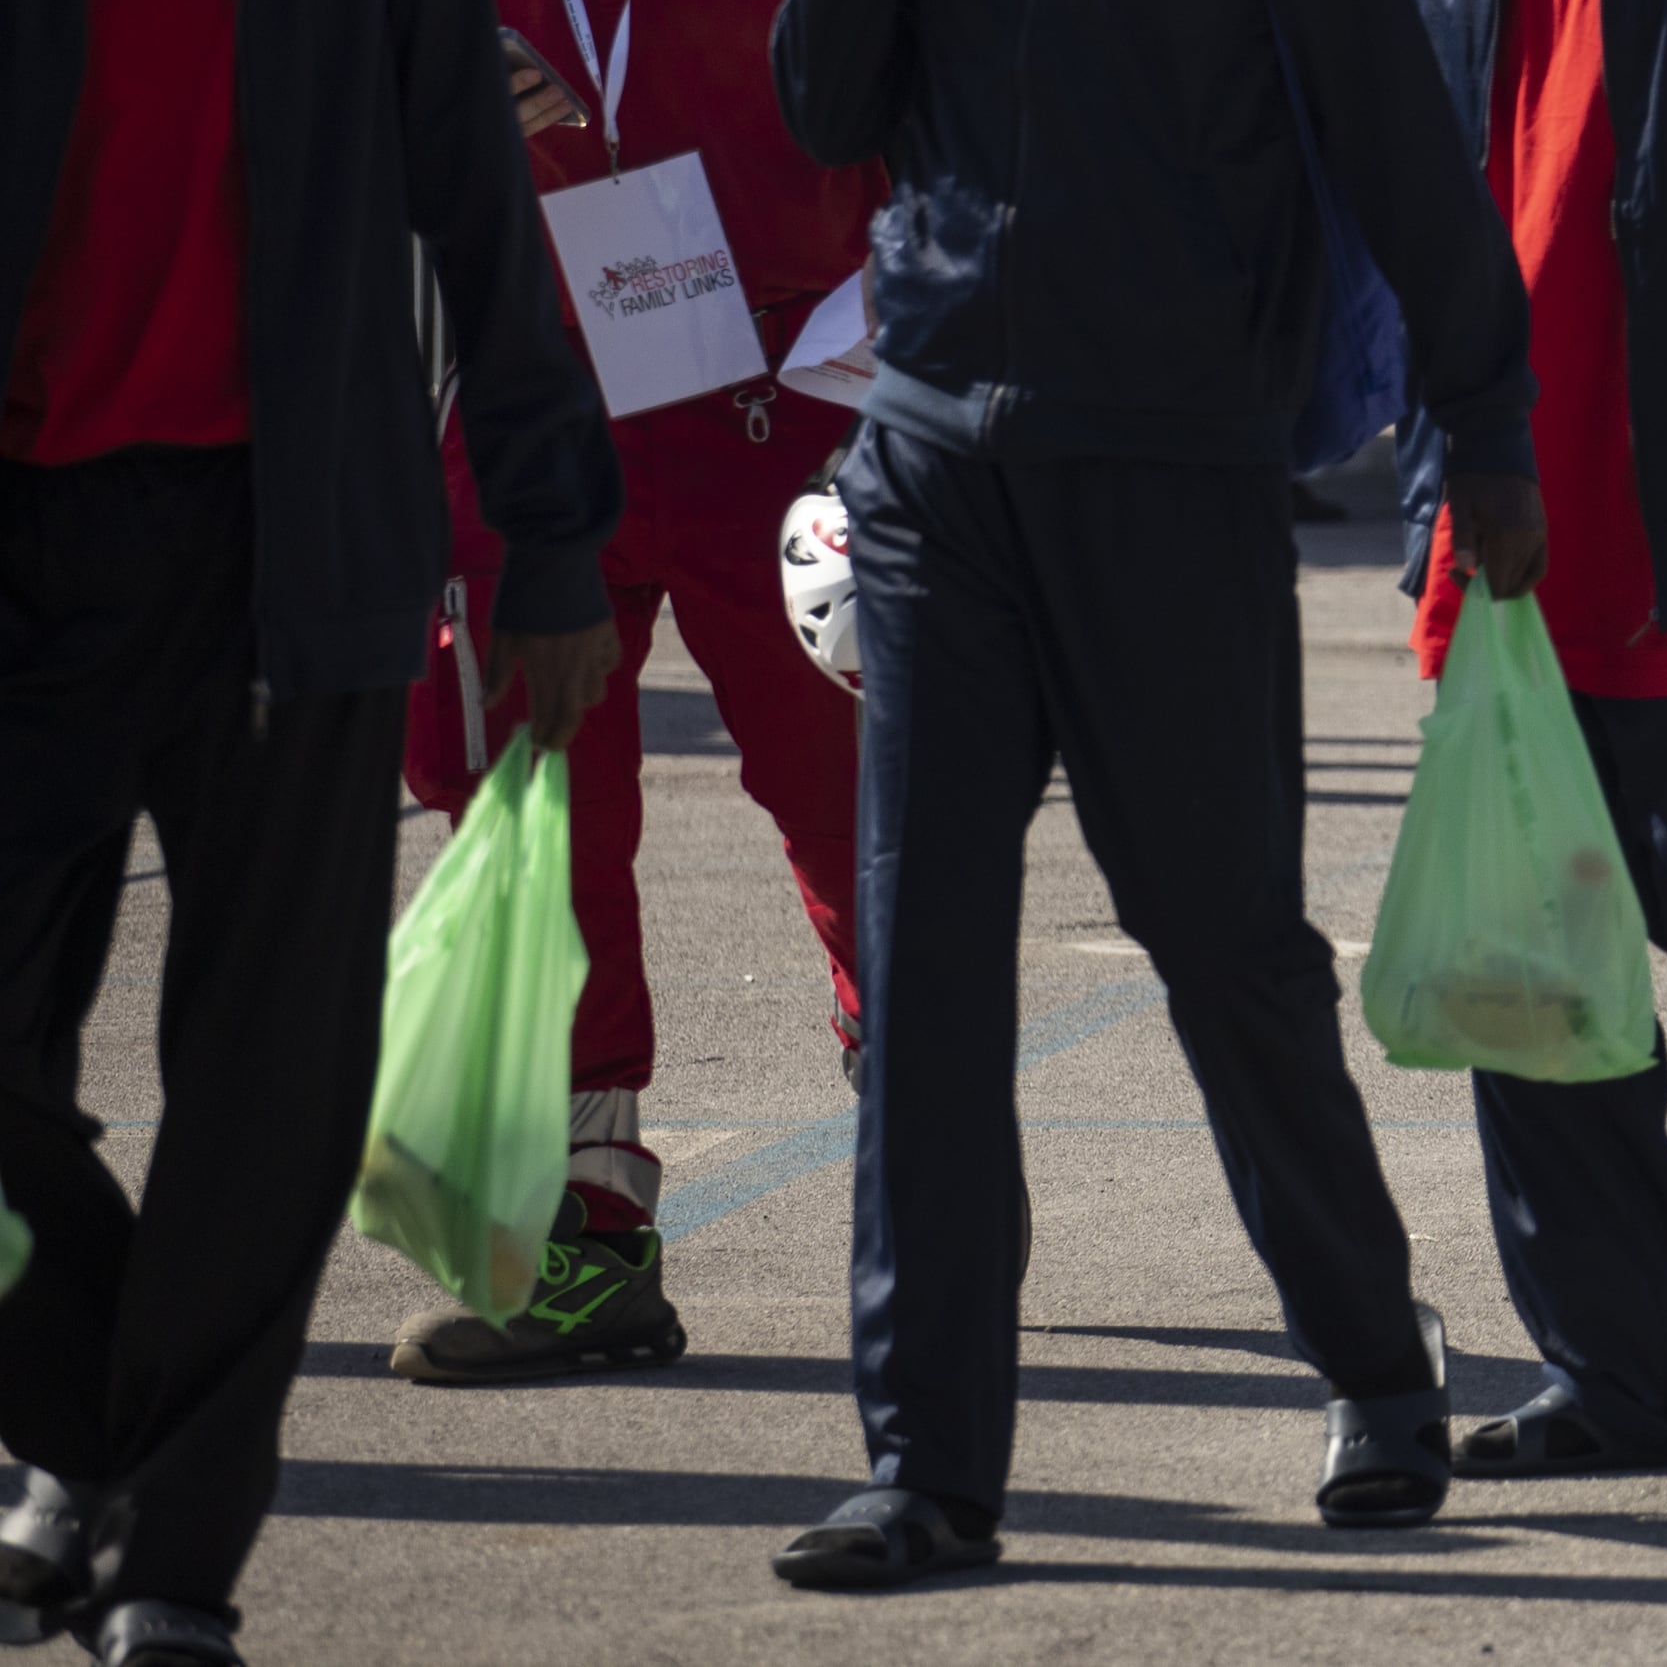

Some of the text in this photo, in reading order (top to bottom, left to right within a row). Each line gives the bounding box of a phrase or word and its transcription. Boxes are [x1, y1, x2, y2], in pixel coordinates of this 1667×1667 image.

[619, 268, 735, 317] FAMILY LINKS
[632, 249, 729, 293] RESTORING
